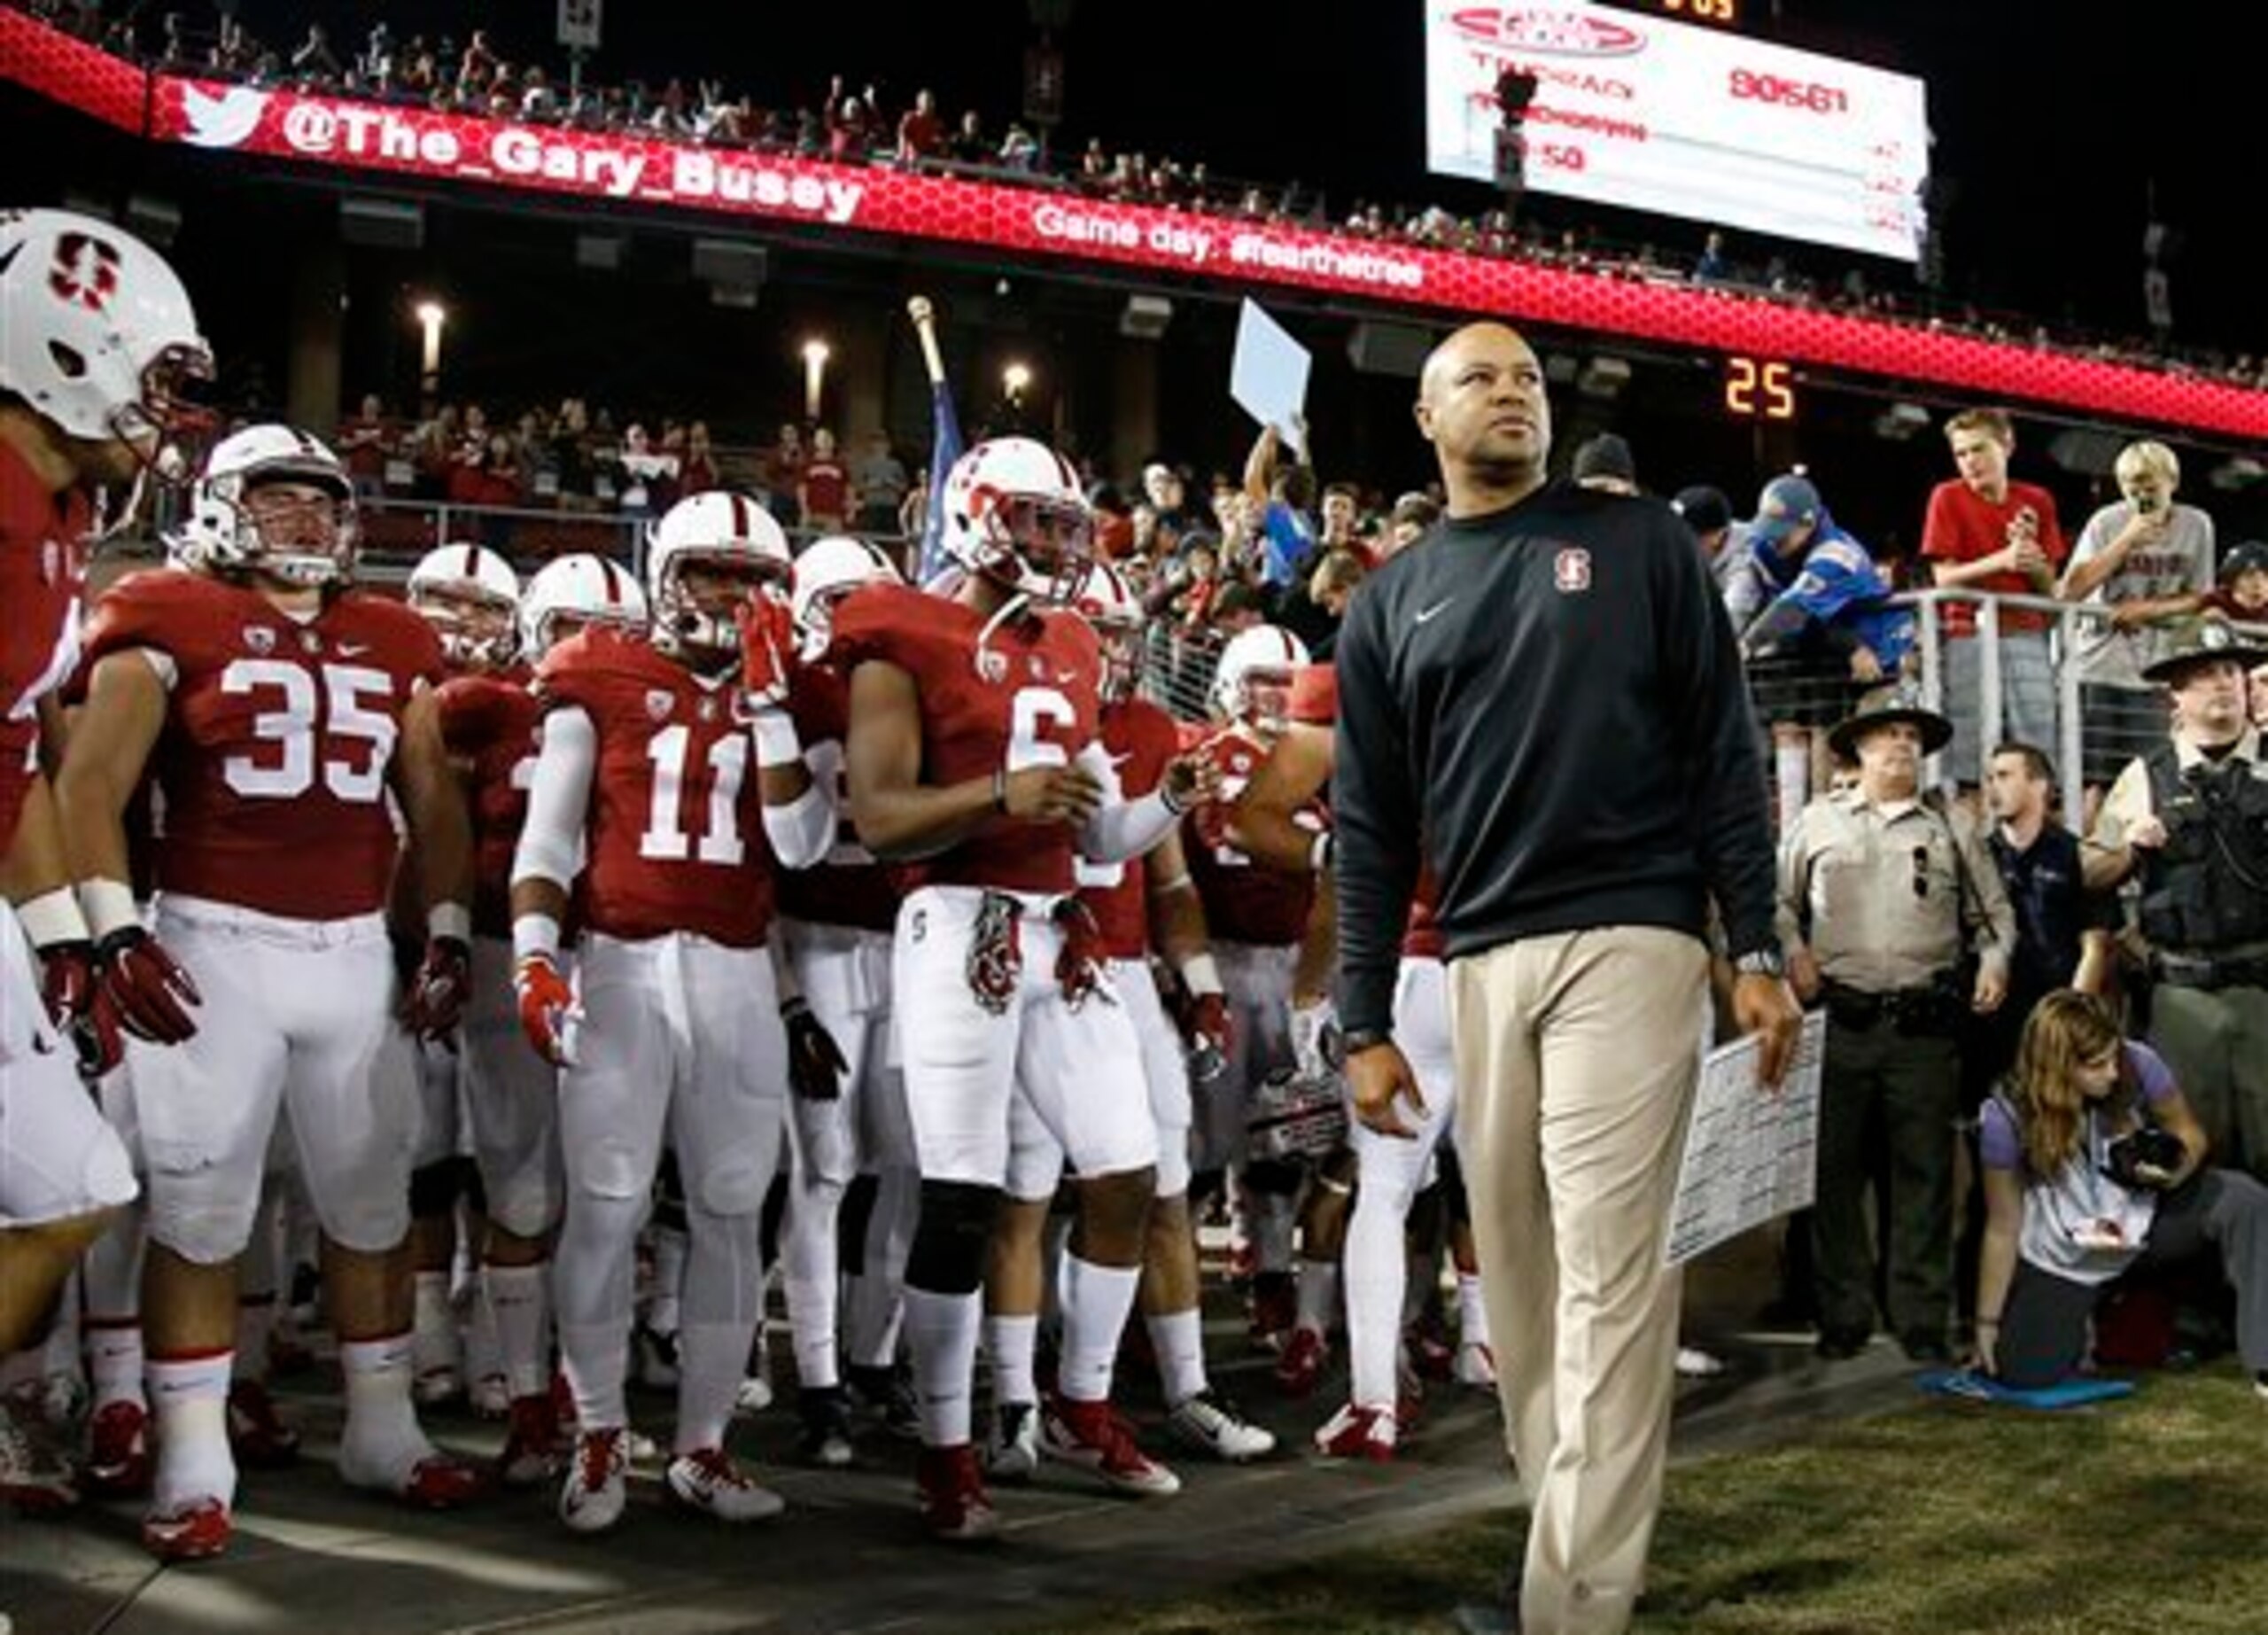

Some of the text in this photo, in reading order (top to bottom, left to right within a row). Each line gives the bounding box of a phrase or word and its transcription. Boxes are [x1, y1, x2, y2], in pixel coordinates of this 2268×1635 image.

[283, 103, 863, 224] @The_Gary_Busey
[1035, 204, 1138, 247] Game
[1231, 233, 1424, 288] #fearthetree
[1728, 358, 1794, 417] 25
[221, 658, 399, 803] 35
[641, 724, 746, 865] 11
